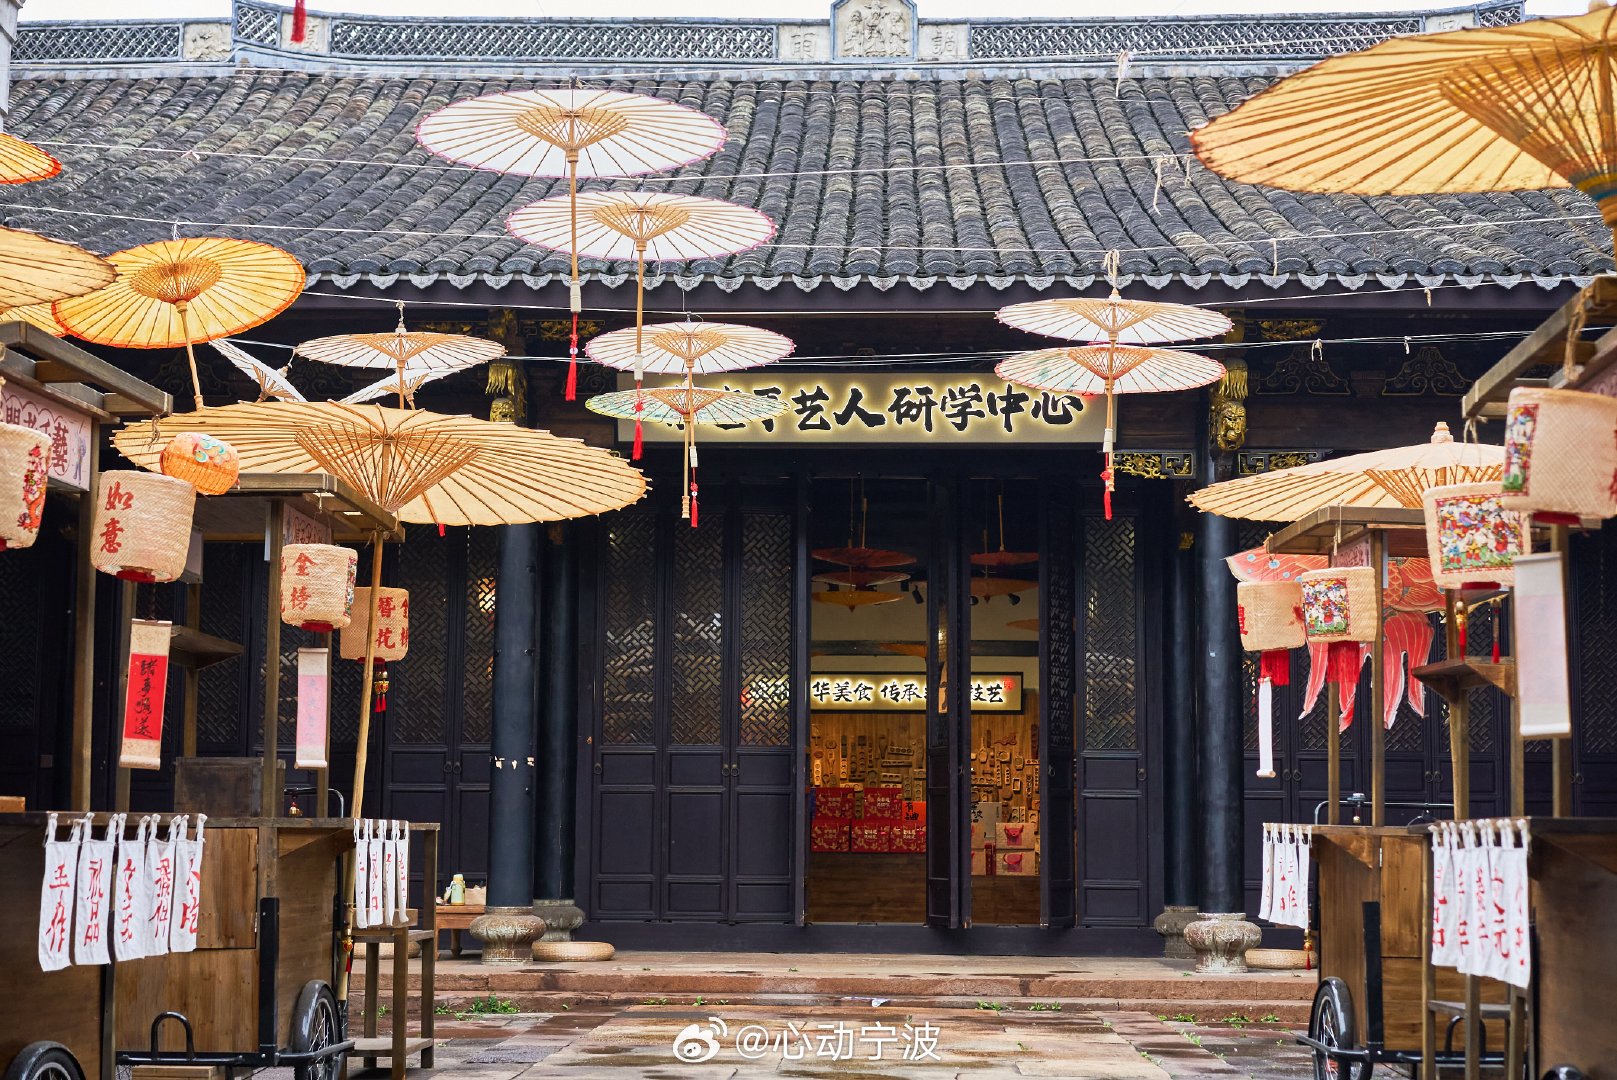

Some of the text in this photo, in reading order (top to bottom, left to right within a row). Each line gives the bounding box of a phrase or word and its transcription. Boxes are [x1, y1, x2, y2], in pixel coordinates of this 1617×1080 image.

[666, 383, 1084, 433] 艺人研学中心
[99, 481, 134, 554] 如意
[290, 552, 318, 611] 金榜
[811, 681, 874, 703] 华美食
